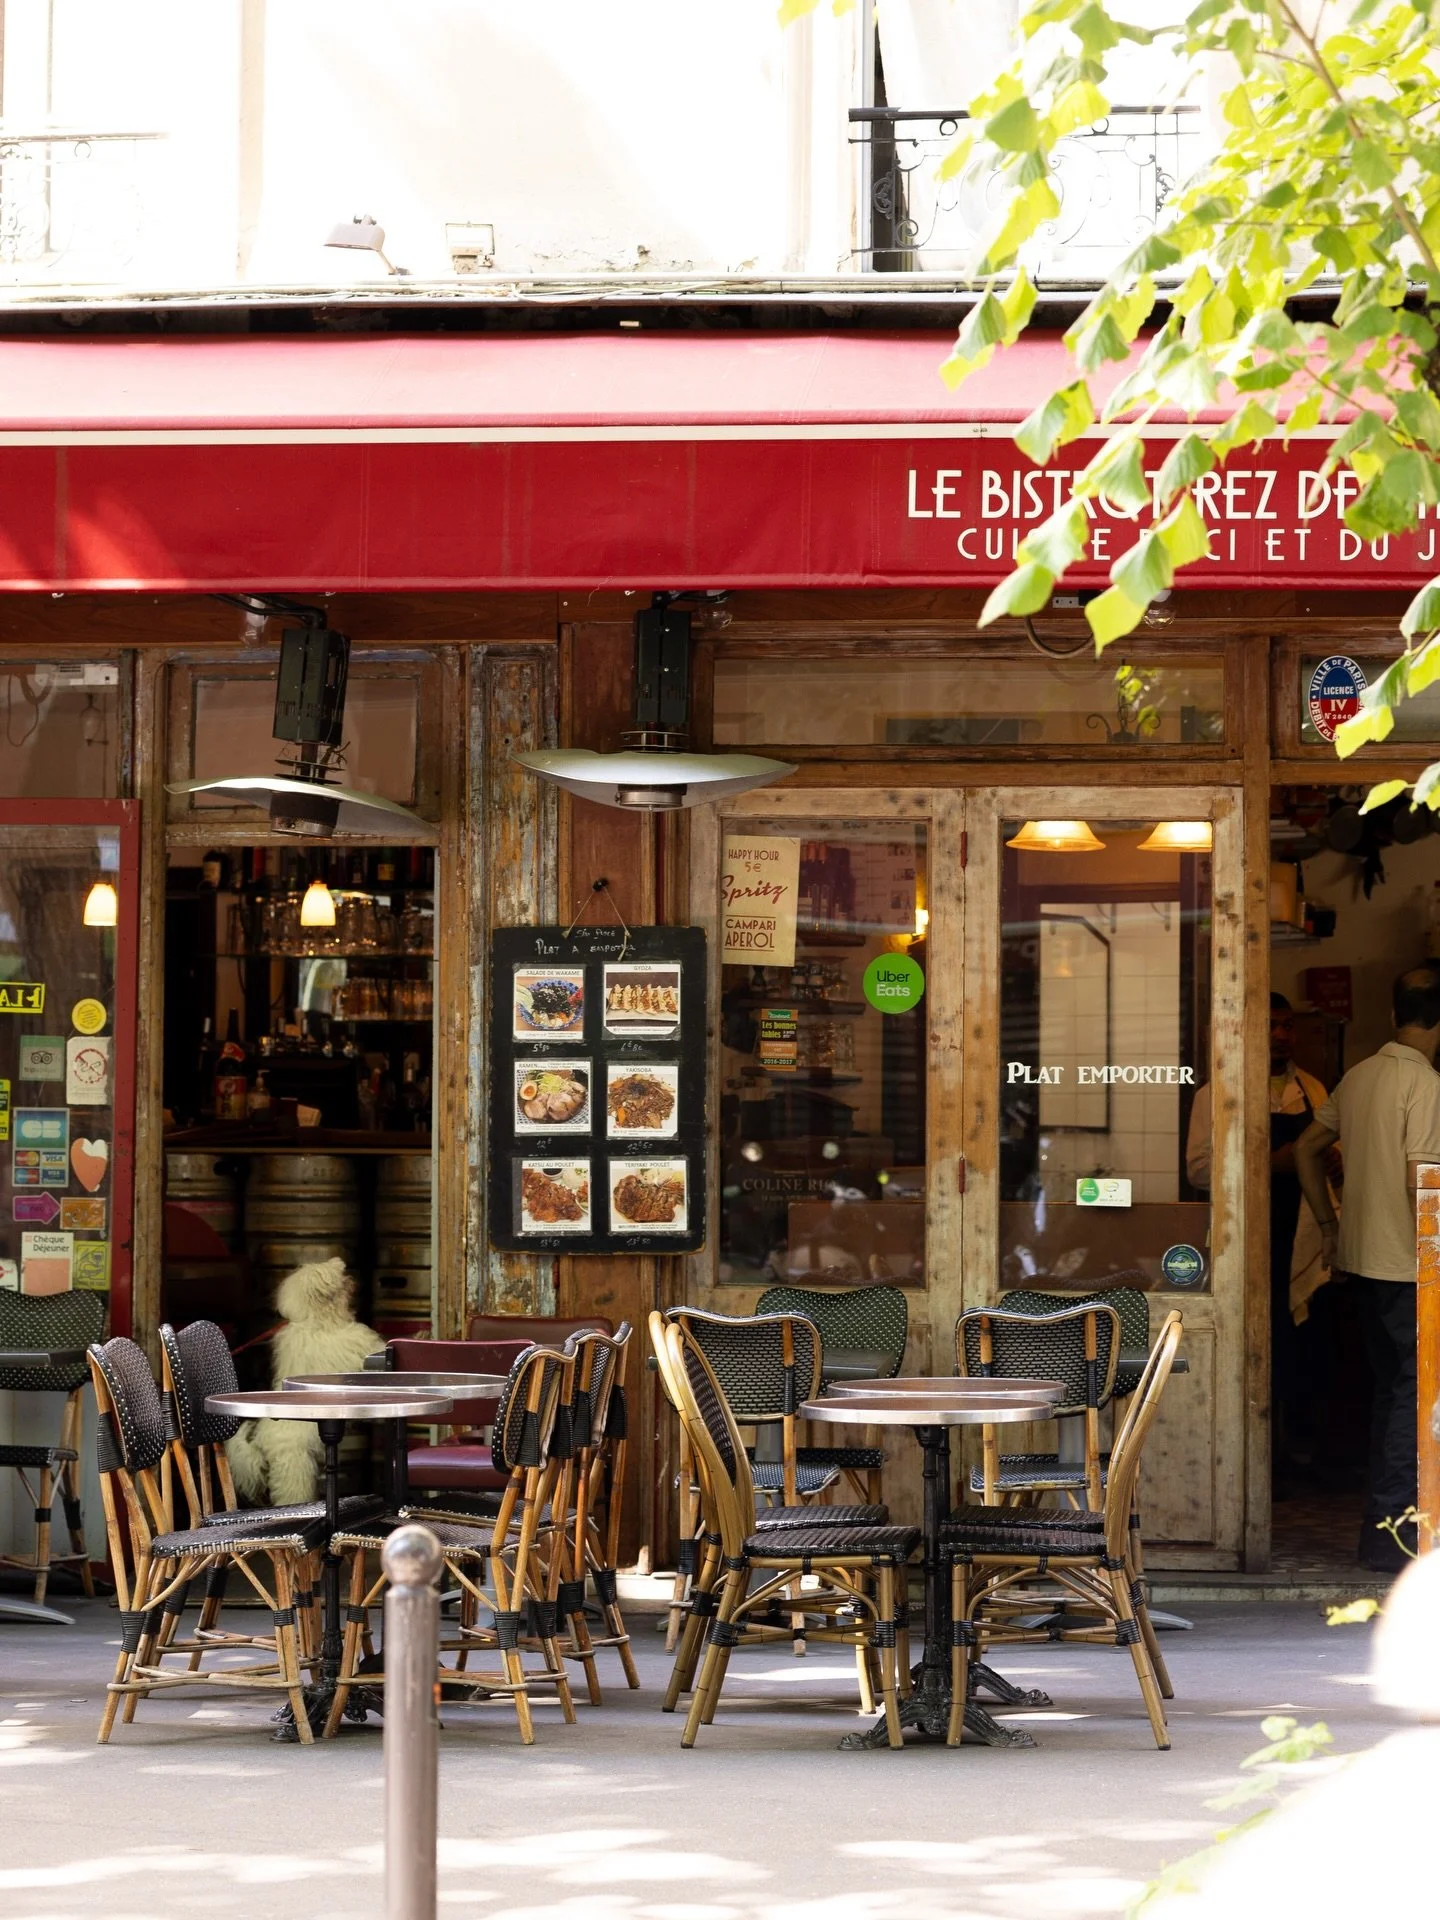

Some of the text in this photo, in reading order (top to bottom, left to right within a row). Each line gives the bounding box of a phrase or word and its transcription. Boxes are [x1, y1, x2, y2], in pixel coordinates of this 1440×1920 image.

[908, 470, 962, 518] LE
[1265, 528, 1312, 561] ET
[1340, 528, 1389, 561] DU
[1311, 659, 1366, 692] VILLE DE PARIS
[1323, 686, 1354, 695] LICENCE
[1330, 699, 1348, 712] IV
[728, 849, 780, 861] HAPPY HOUR
[744, 862, 762, 872] 5€
[721, 875, 788, 907] Spritz
[725, 918, 776, 931] CAMPARI
[724, 931, 775, 948] APEROL
[876, 970, 911, 984] Uber
[876, 984, 911, 997] Eats
[1077, 1065, 1195, 1085] EMPORTER
[33, 1235, 66, 1245] Chèque
[33, 1244, 70, 1254] Déjeuner
